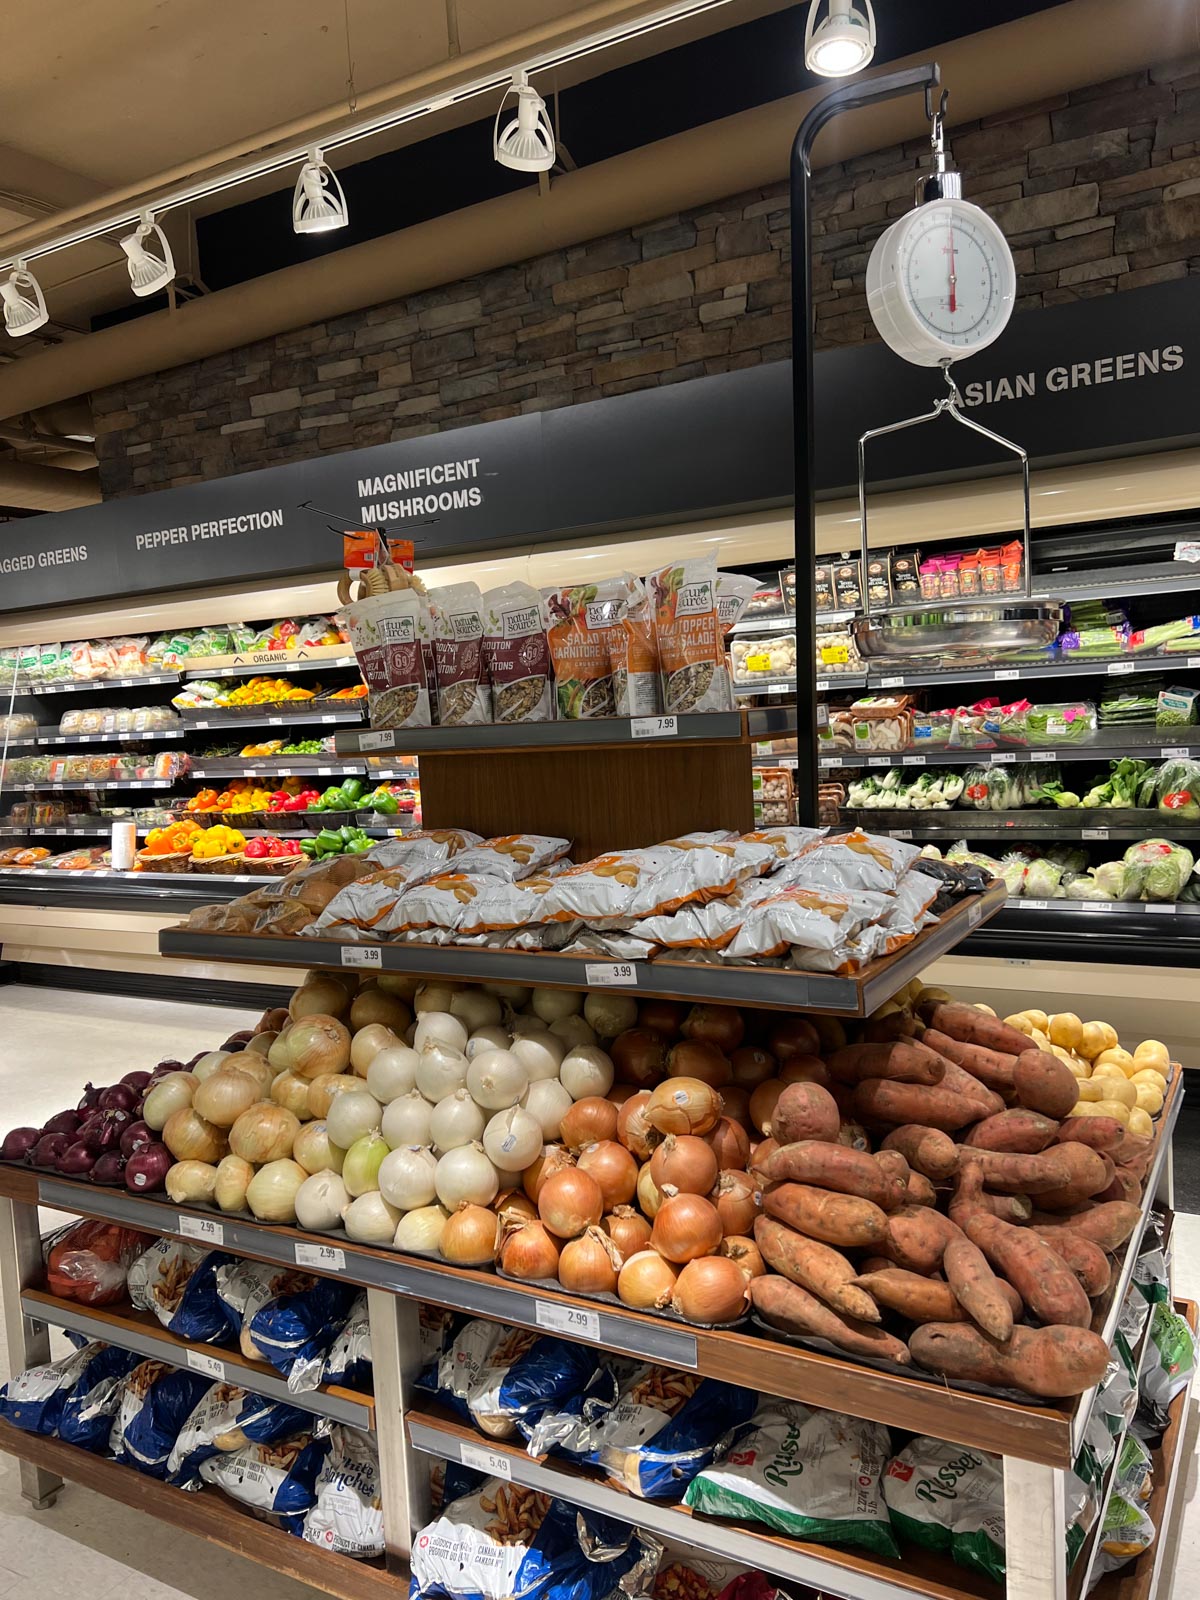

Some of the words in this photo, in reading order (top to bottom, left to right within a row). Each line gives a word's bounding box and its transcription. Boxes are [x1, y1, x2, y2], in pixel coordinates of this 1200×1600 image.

[949, 372, 1036, 409] ASIAN
[1045, 345, 1184, 393] GREENS
[357, 457, 480, 498] MAGNIFICENT
[360, 487, 482, 525] MUSHROOMS
[135, 526, 188, 551] PEPPER
[190, 509, 283, 542] PERFECTION
[38, 545, 88, 568] GREENS
[507, 619, 537, 632] source
[679, 616, 716, 634] TOPPER
[567, 632, 600, 646] SALAD
[680, 631, 716, 649] SALADE
[253, 652, 288, 663] ORGANIC
[553, 645, 601, 660] GARNITURE
[658, 718, 674, 729] 7.99
[379, 732, 392, 742] 7.99
[364, 949, 379, 960] 3.99
[613, 965, 632, 978] 3.99
[200, 1221, 215, 1233] 2.99
[319, 1247, 335, 1259] 2.99
[567, 1311, 588, 1327] 2.99
[207, 1359, 222, 1373] 5.49
[343, 1456, 374, 1479] hite
[489, 1456, 508, 1471] 5.49
[357, 1543, 376, 1552] CANADA
[477, 1545, 497, 1557] CANADA
[474, 1555, 494, 1567] CANADA
